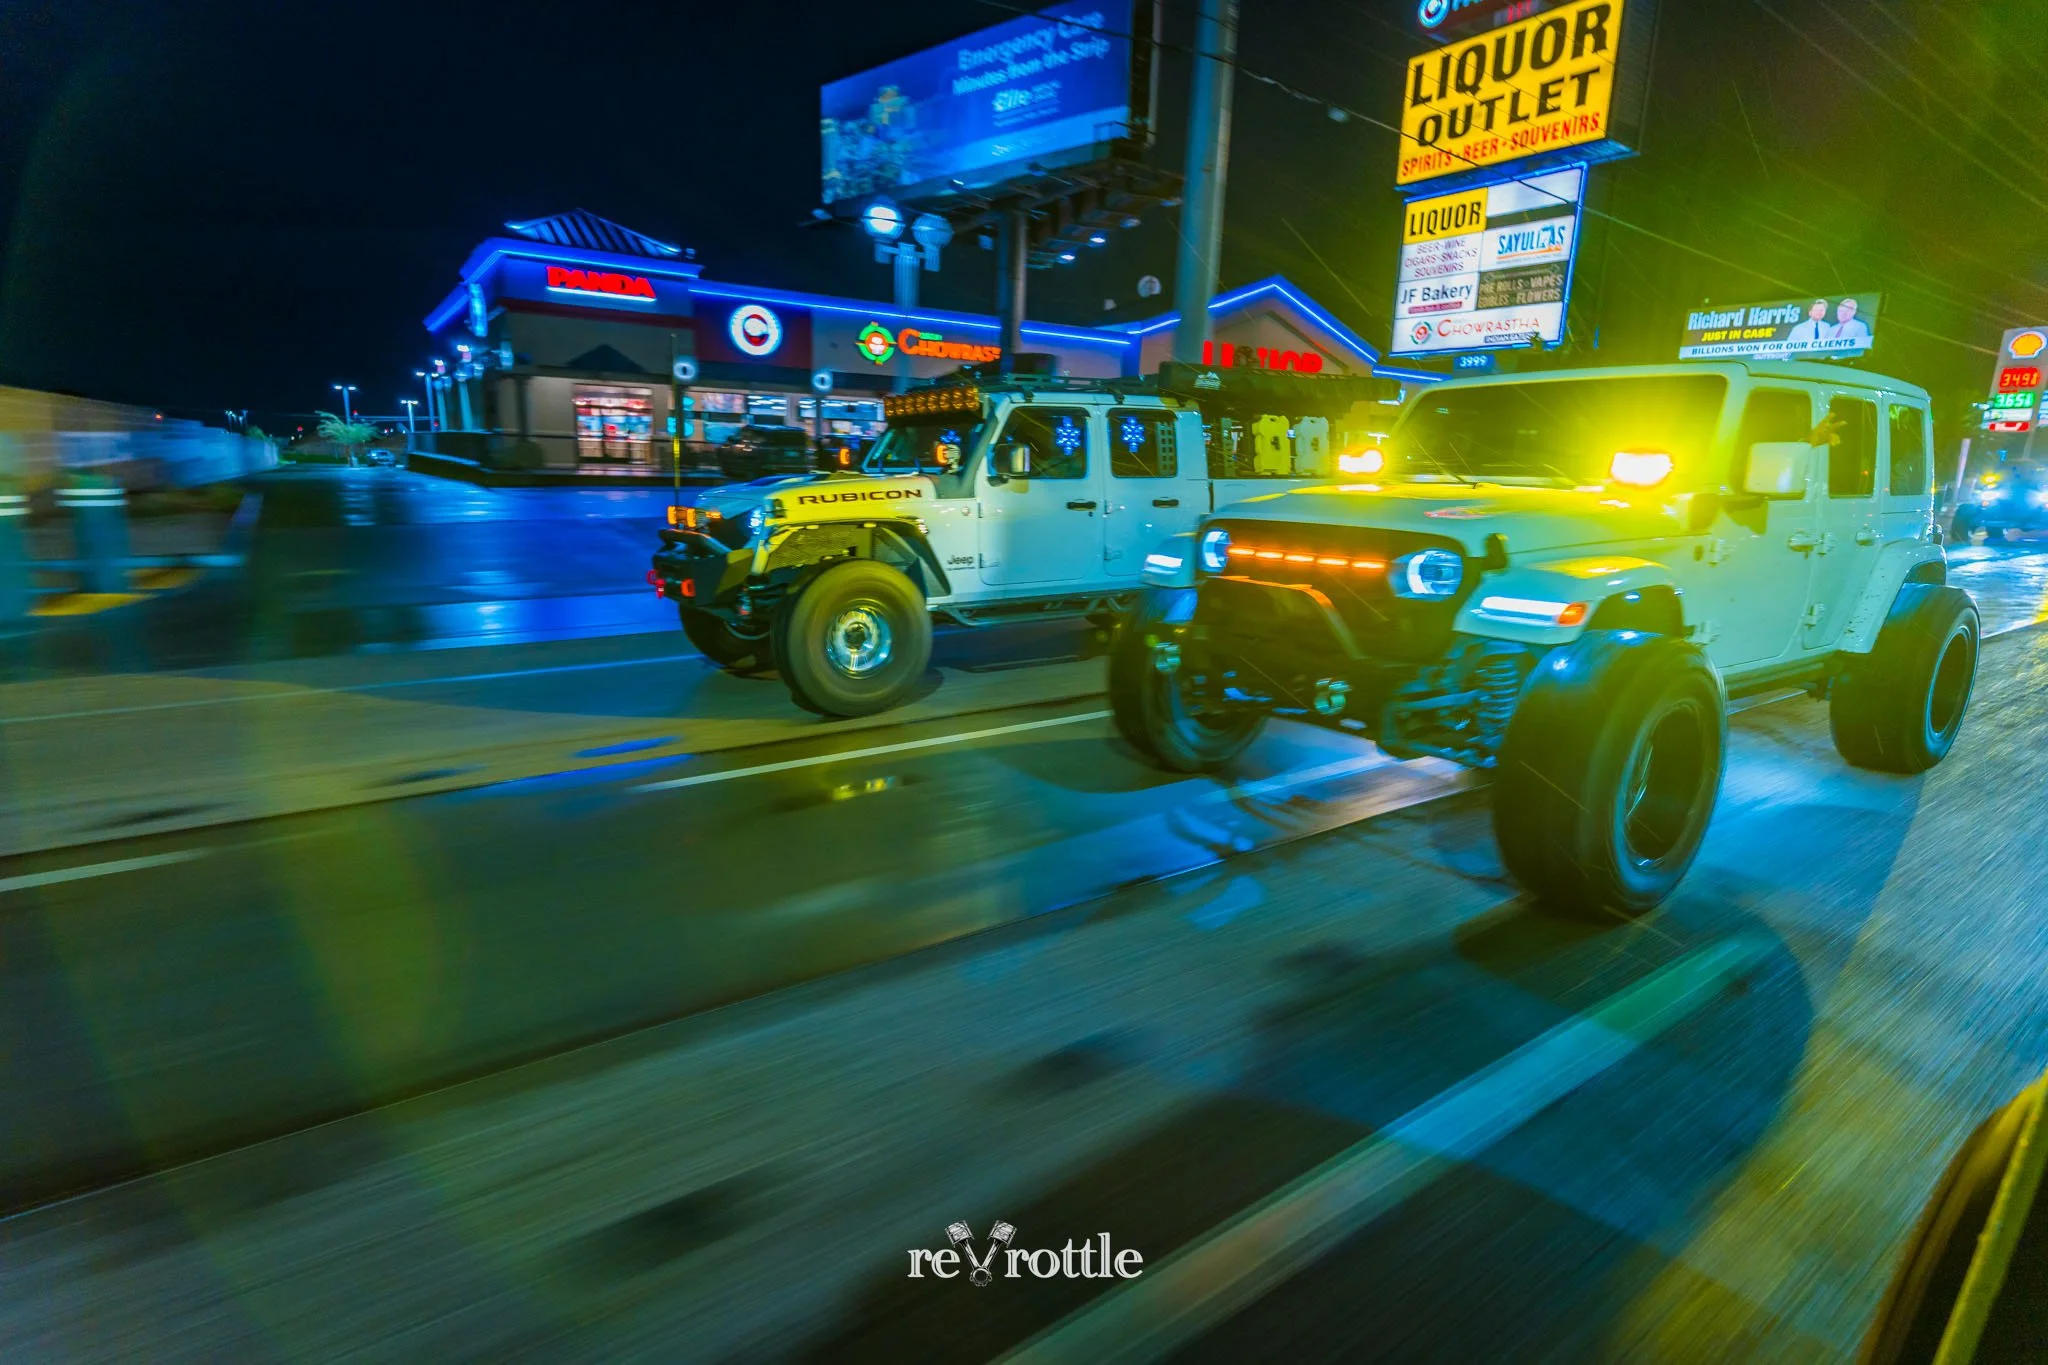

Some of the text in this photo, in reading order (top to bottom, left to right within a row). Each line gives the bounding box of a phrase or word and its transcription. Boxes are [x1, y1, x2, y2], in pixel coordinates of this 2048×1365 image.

[958, 27, 1058, 70] Emergency
[1411, 4, 1611, 108] LIQUOR
[1418, 67, 1600, 147] OUTLET
[1402, 112, 1600, 177] SPIRITS BEER SOUVENIRS
[1409, 201, 1482, 236] LIQUOR
[1414, 262, 1464, 279] SOUVENIRS
[1530, 272, 1563, 287] VAPES
[546, 266, 656, 299] PANDA
[1401, 284, 1473, 304] JF Bakery
[1516, 288, 1562, 304] FLOWERS
[1688, 303, 1802, 331] Richard Harris
[1436, 317, 1541, 338] CHOWRASTHA
[1701, 330, 1728, 342] JUST
[1729, 329, 1742, 340] IN
[1692, 338, 1857, 355] BILLIONS WON FOR OUR CLIENTS
[1459, 356, 1488, 367] 3999
[798, 489, 923, 505] RUBICON
[947, 554, 974, 566] Jeep
